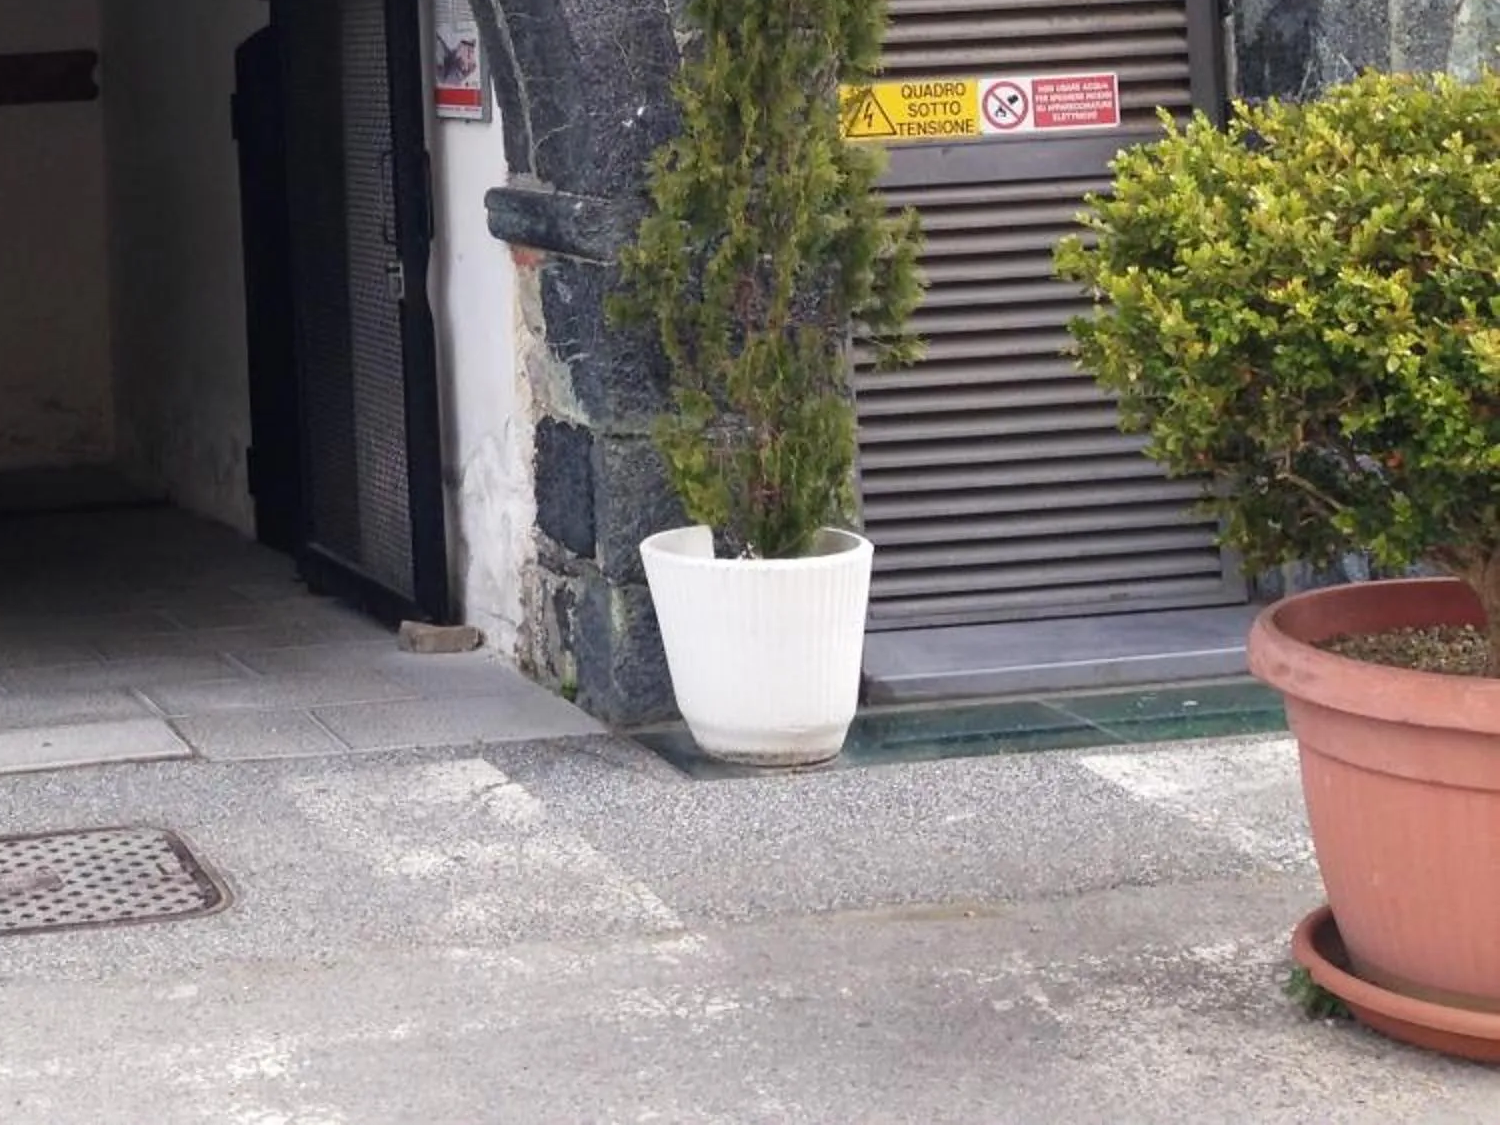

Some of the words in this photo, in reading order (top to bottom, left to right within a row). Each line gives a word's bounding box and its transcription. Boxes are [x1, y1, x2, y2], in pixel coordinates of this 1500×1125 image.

[901, 82, 966, 99] QUADRO
[907, 101, 961, 117] SOTTO
[896, 119, 975, 135] TENSIONE
